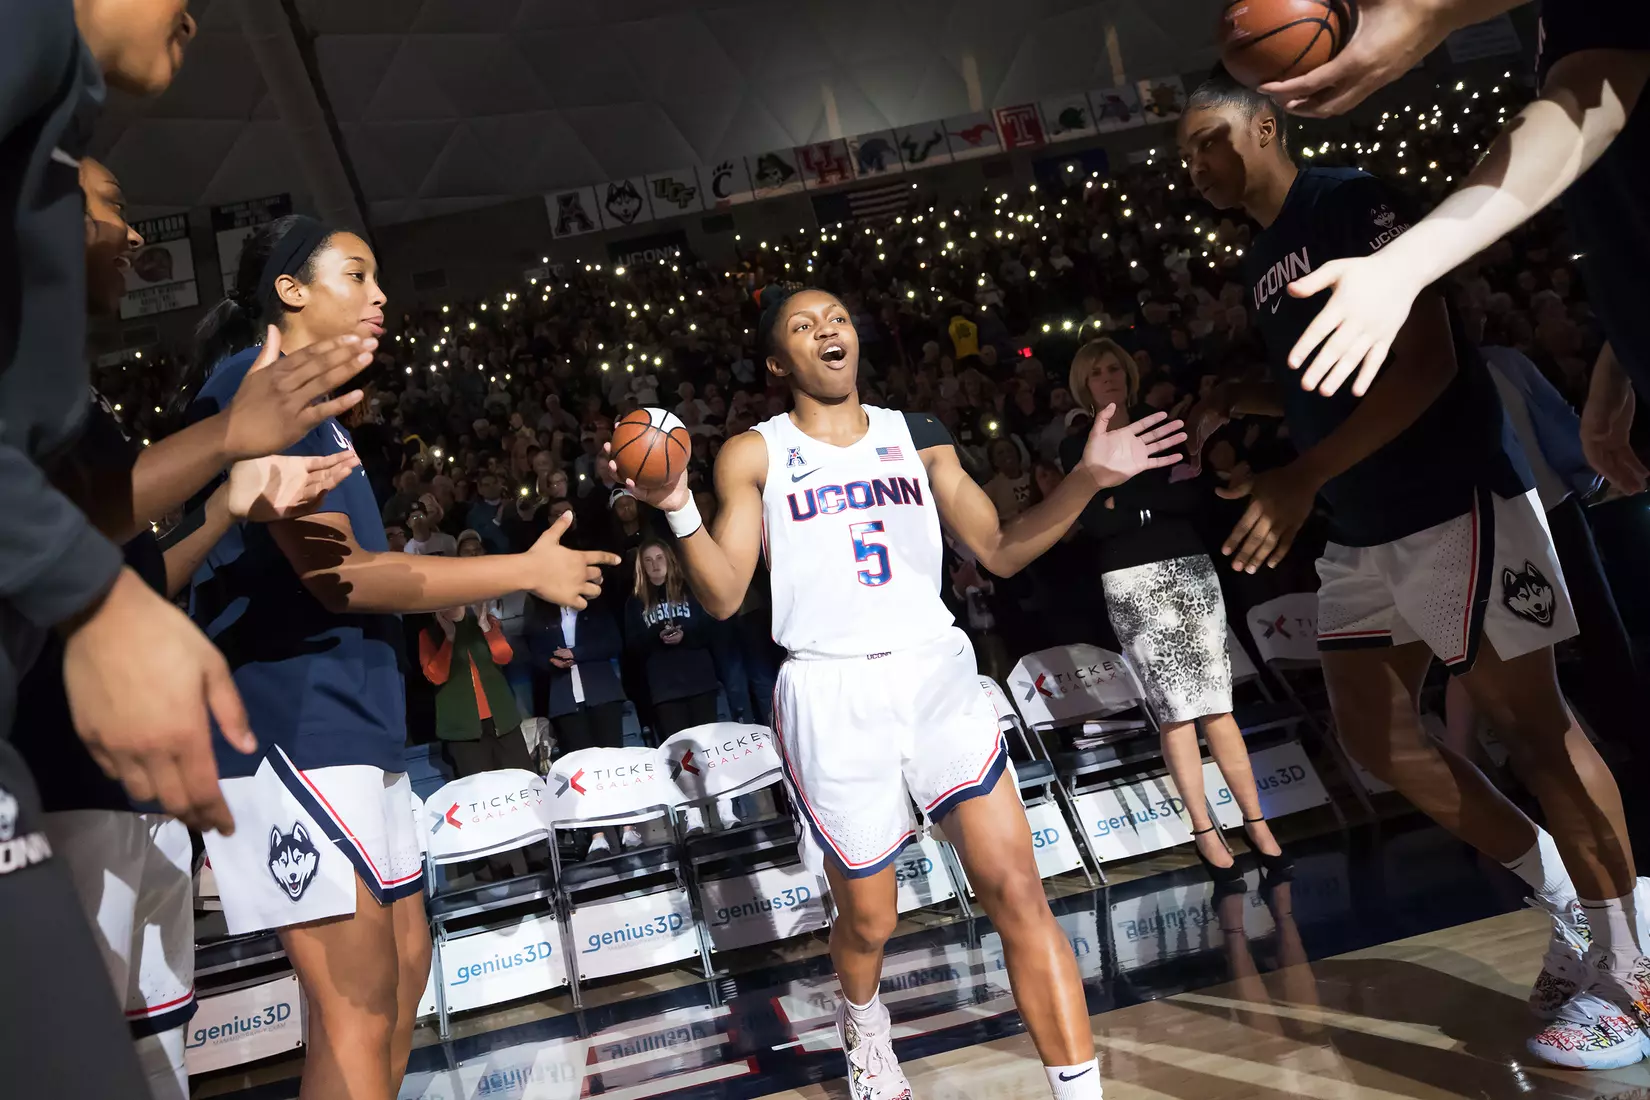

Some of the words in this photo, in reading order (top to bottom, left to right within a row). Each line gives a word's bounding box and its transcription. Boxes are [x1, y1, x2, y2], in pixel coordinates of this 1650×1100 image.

[652, 177, 696, 209] UCF
[1368, 222, 1412, 251] UCON
[1253, 245, 1312, 310] UCONN
[786, 476, 924, 522] UCONN
[848, 519, 893, 588] 5
[641, 600, 692, 629] HUSKIES
[866, 650, 892, 661] UCONN
[593, 762, 654, 781] TICKE
[708, 742, 765, 769] GALAX
[469, 788, 543, 813] TICKET
[596, 775, 656, 791] GALAX
[1216, 764, 1306, 806] gus3D
[472, 799, 543, 824] GALAXY
[1094, 797, 1186, 838] genius3D
[711, 886, 811, 927] genius3D
[582, 912, 683, 954] genius3D
[450, 941, 552, 986] genius3D
[185, 1002, 291, 1049] genius3D
